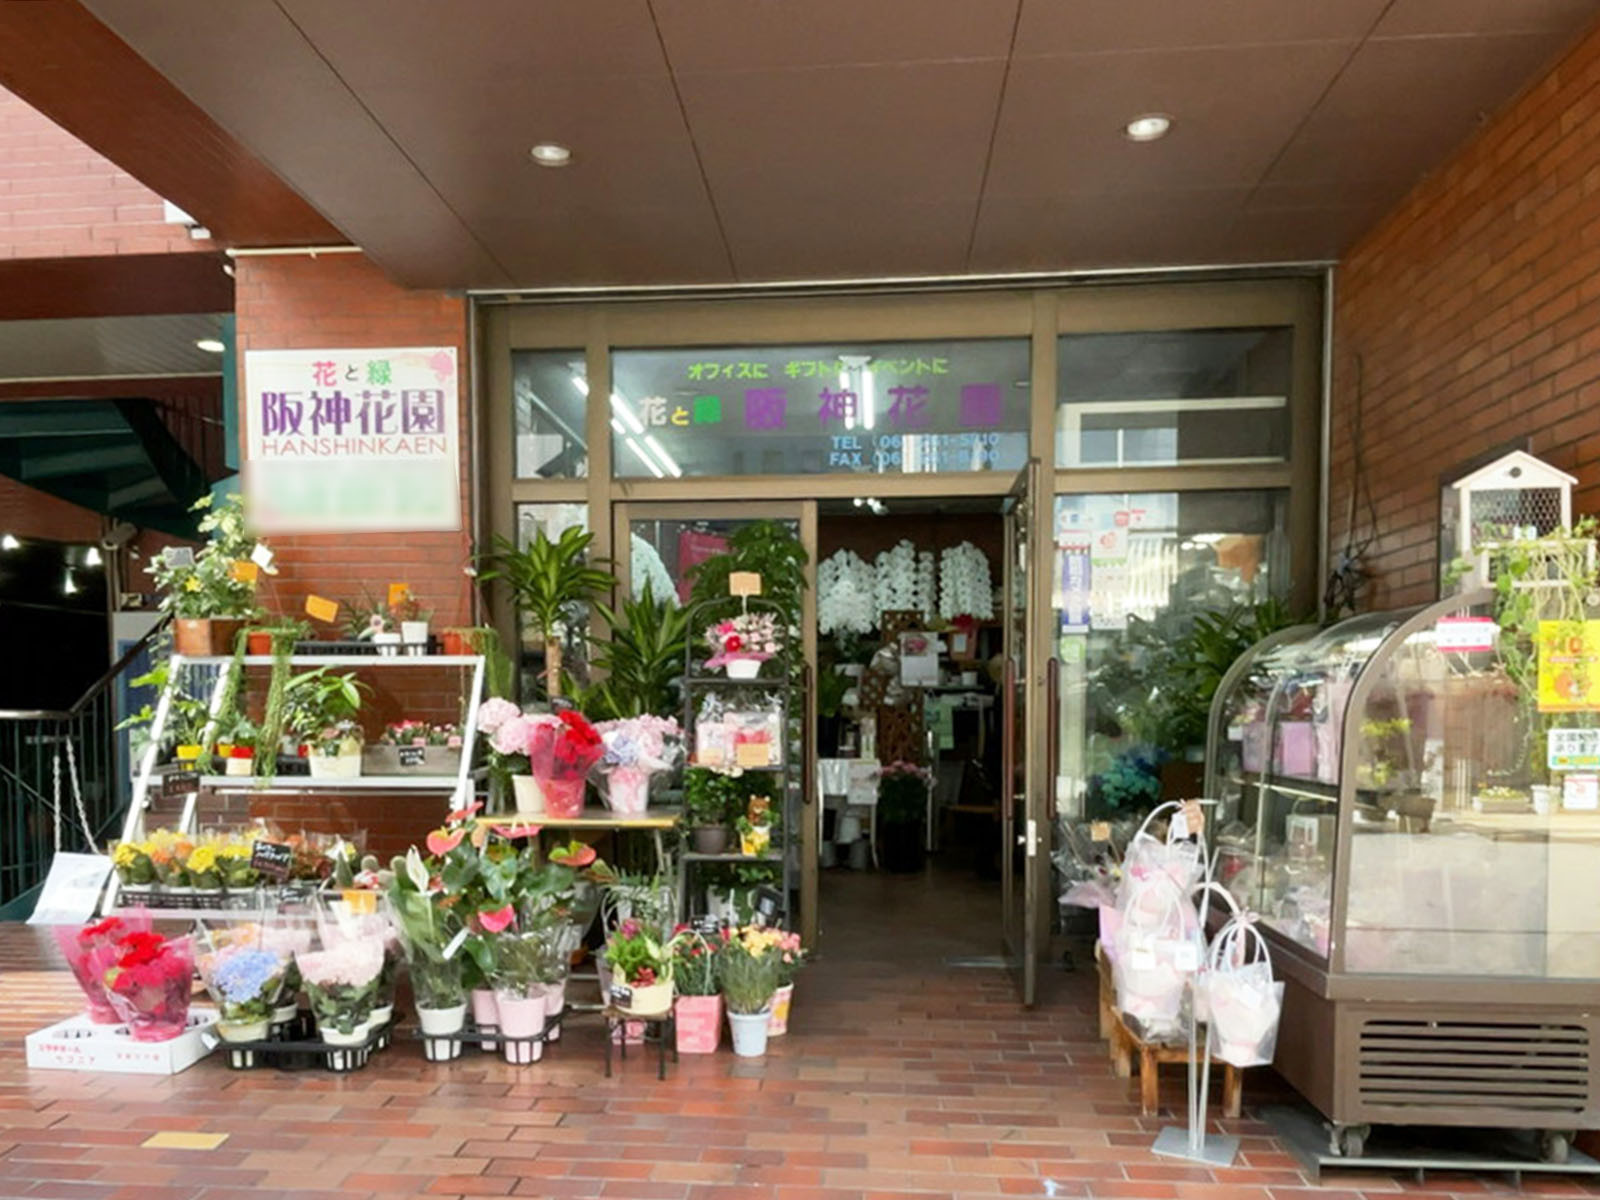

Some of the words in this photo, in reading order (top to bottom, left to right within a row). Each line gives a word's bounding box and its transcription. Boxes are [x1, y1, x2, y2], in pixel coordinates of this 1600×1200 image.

[312, 360, 392, 386] 花と緑
[688, 361, 768, 380] オフィスに
[261, 389, 446, 436] 阪神花園
[261, 436, 447, 456] HANSHINKAEN
[832, 435, 862, 451] TEL
[829, 452, 862, 467] FAX
